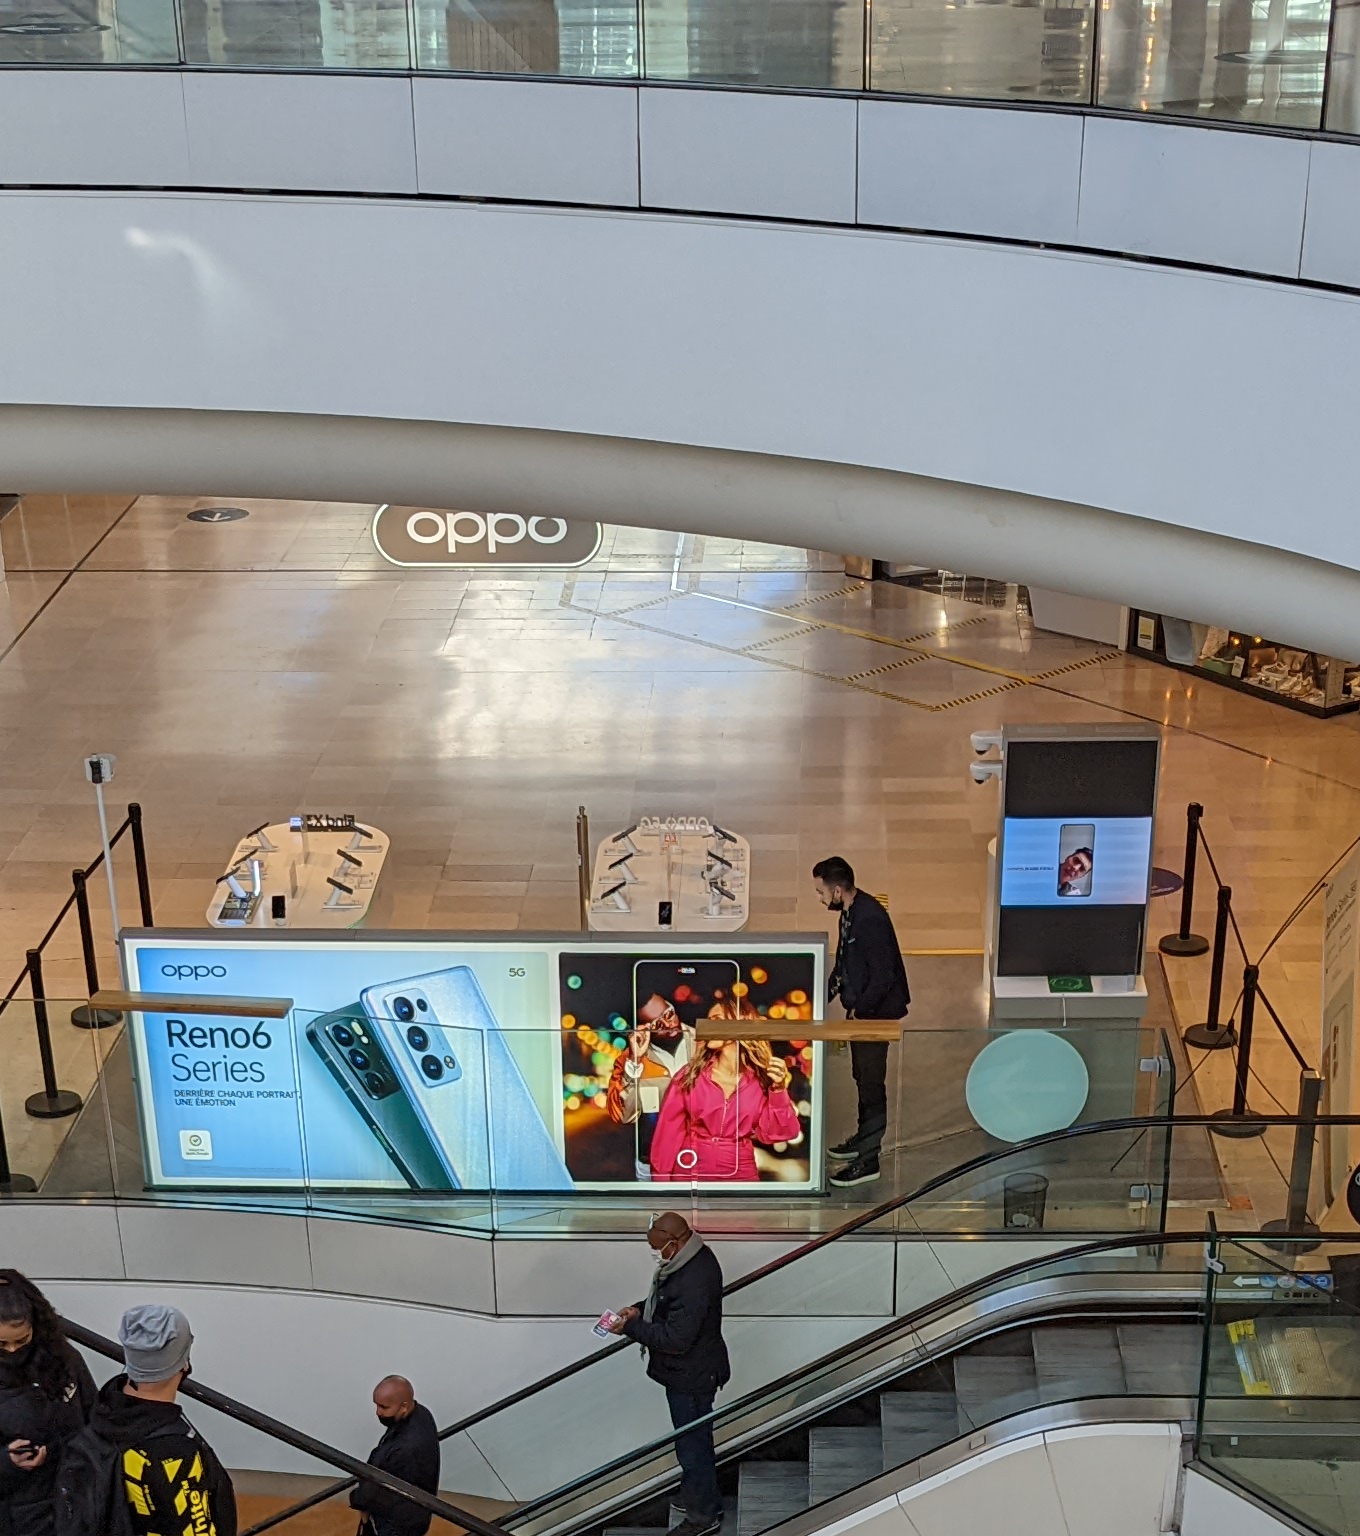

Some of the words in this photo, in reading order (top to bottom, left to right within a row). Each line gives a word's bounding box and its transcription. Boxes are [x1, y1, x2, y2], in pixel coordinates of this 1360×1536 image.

[406, 511, 568, 554] oppo
[161, 964, 227, 981] oppo
[508, 967, 526, 978] 5G
[166, 1019, 272, 1049] Reno6
[171, 1053, 265, 1083] Series
[174, 1088, 215, 1098] DERRIÈRE
[217, 1090, 254, 1098] CHAQUE
[175, 1098, 193, 1106] UNE
[195, 1096, 236, 1106] ÉMOTION
